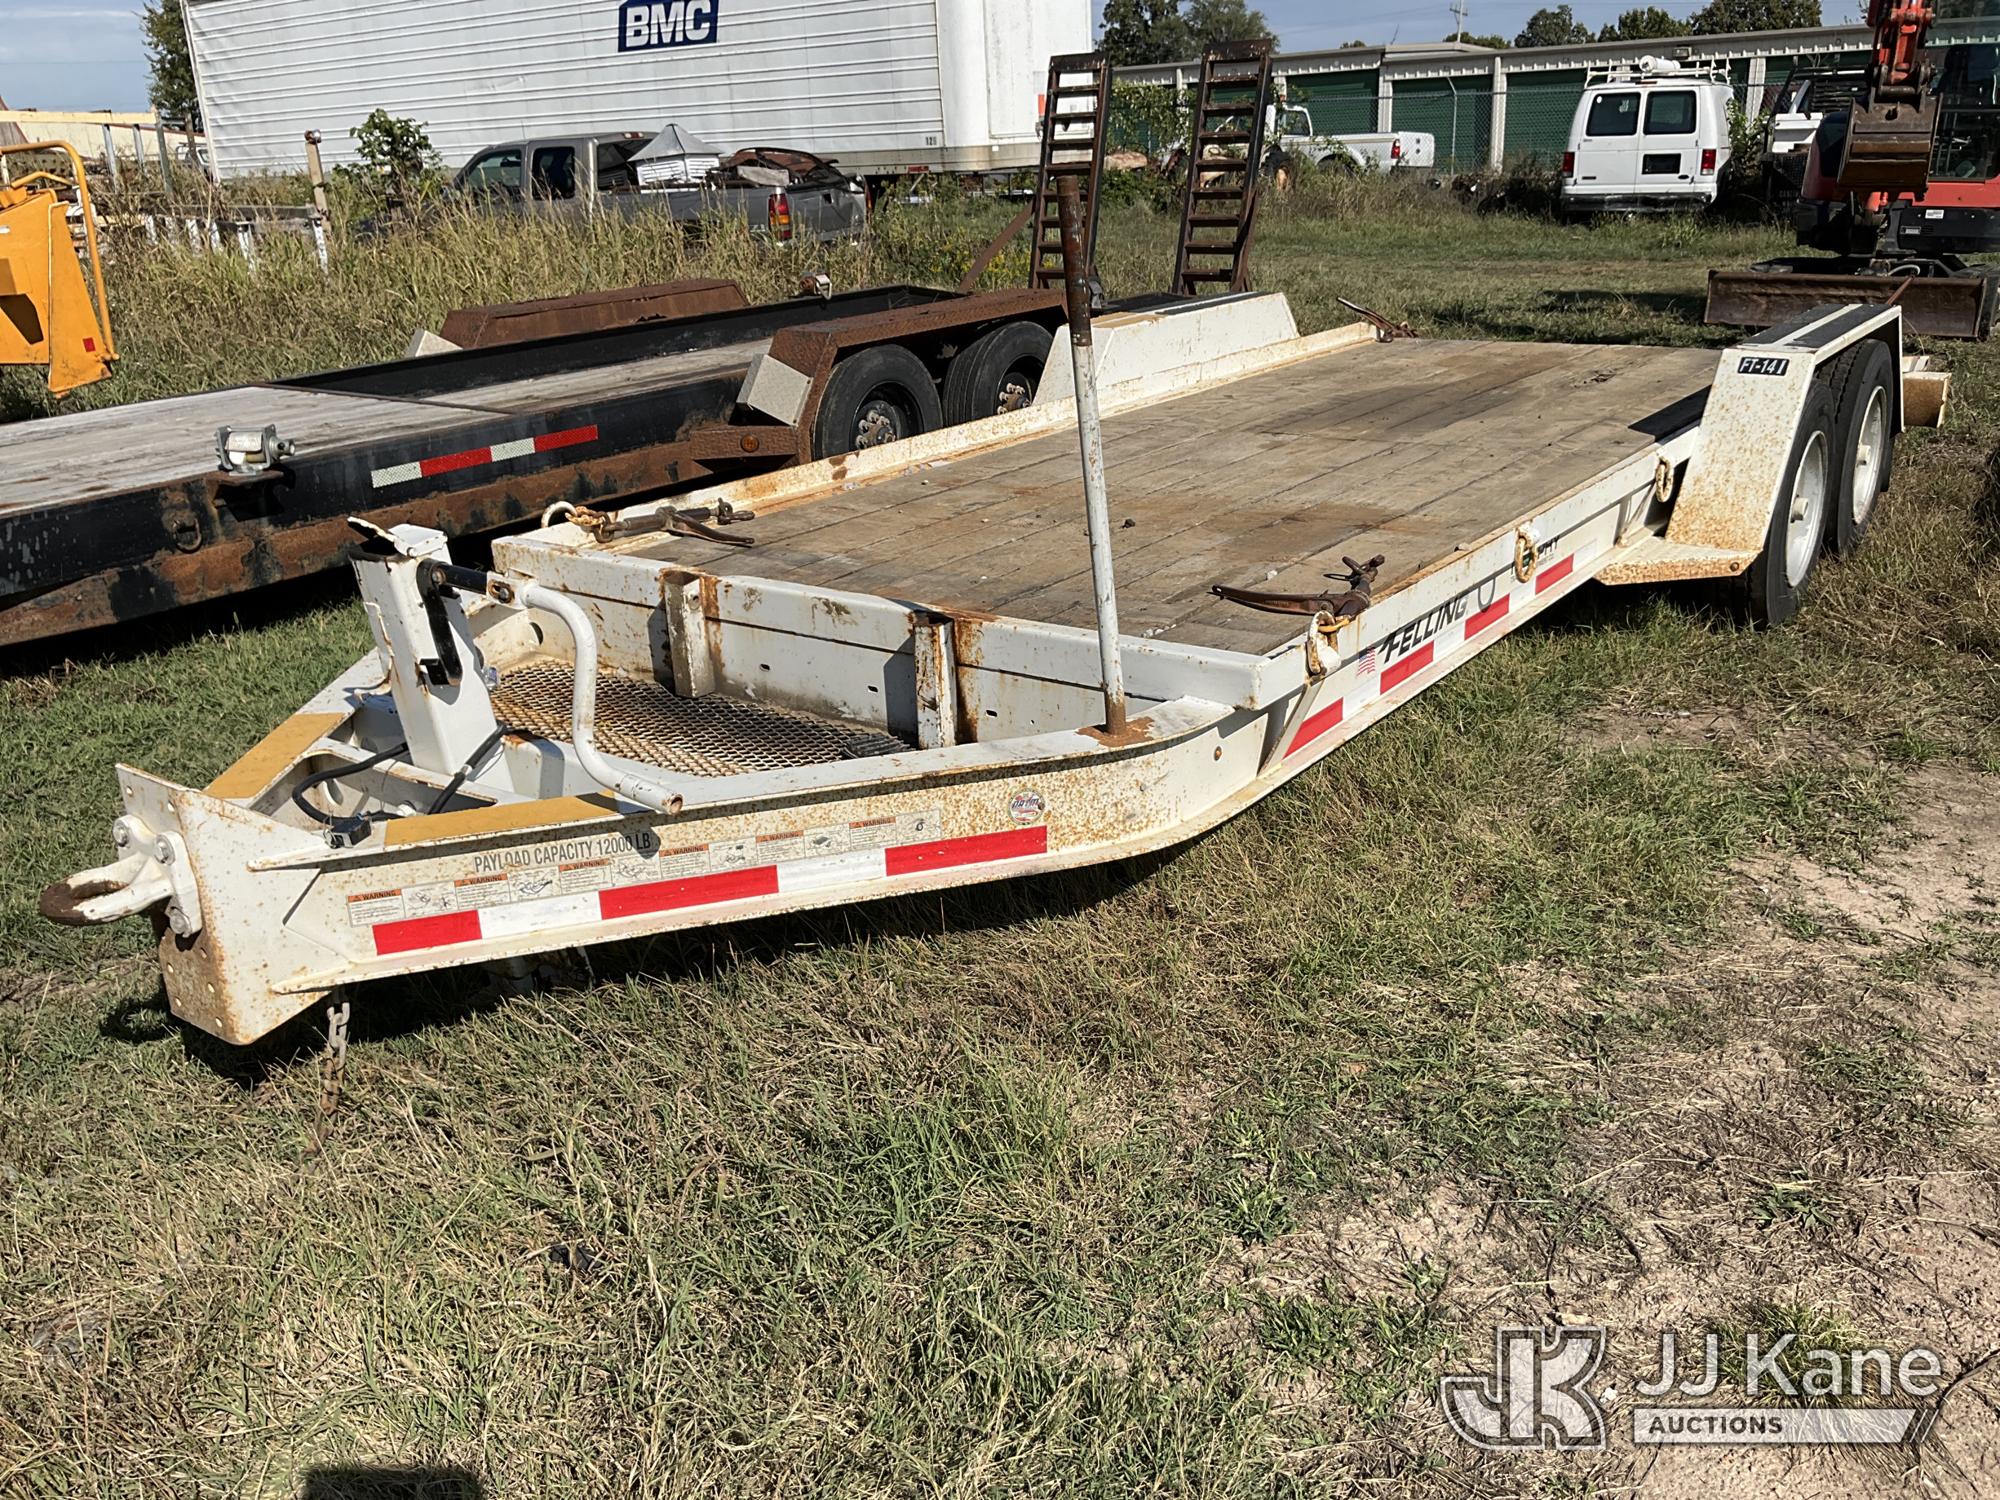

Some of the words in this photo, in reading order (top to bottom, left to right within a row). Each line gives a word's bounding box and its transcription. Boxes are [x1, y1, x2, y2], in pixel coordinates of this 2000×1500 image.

[626, 0, 711, 47] BMC
[1740, 358, 1787, 374] FT-141
[1378, 597, 1468, 664] FELLING
[862, 817, 893, 827] WARNING
[769, 831, 800, 841] WARNING
[474, 850, 531, 873] PAYLOAD
[535, 841, 593, 864] CAPACITY
[597, 834, 632, 857] 12000
[635, 832, 650, 850] LB
[673, 844, 705, 855] WARNING
[573, 859, 606, 870] WARNING
[469, 874, 502, 885] WARNING
[362, 890, 396, 900] WARNING
